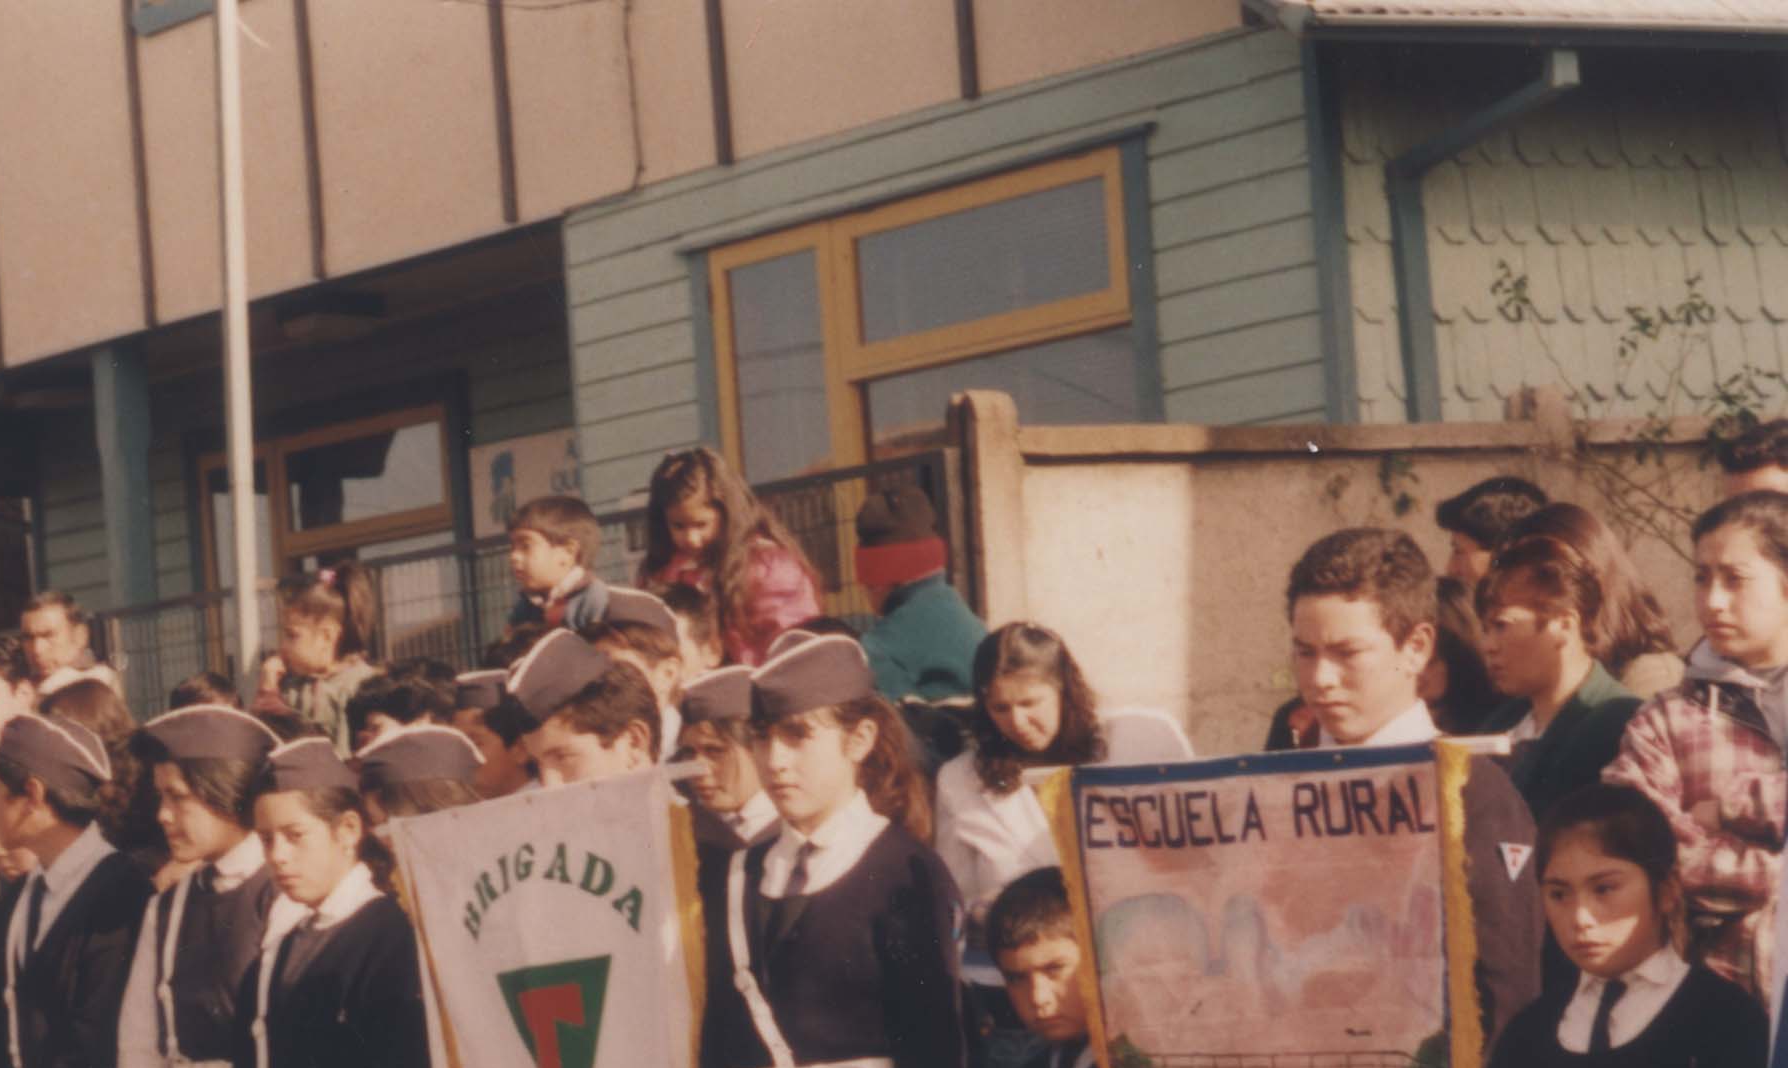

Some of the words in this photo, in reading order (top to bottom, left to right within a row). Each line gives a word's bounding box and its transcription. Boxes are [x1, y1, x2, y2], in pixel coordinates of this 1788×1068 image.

[1086, 789, 1267, 849] ESCUELA
[1292, 776, 1435, 837] RURAL
[464, 843, 645, 941] BRIGADA
